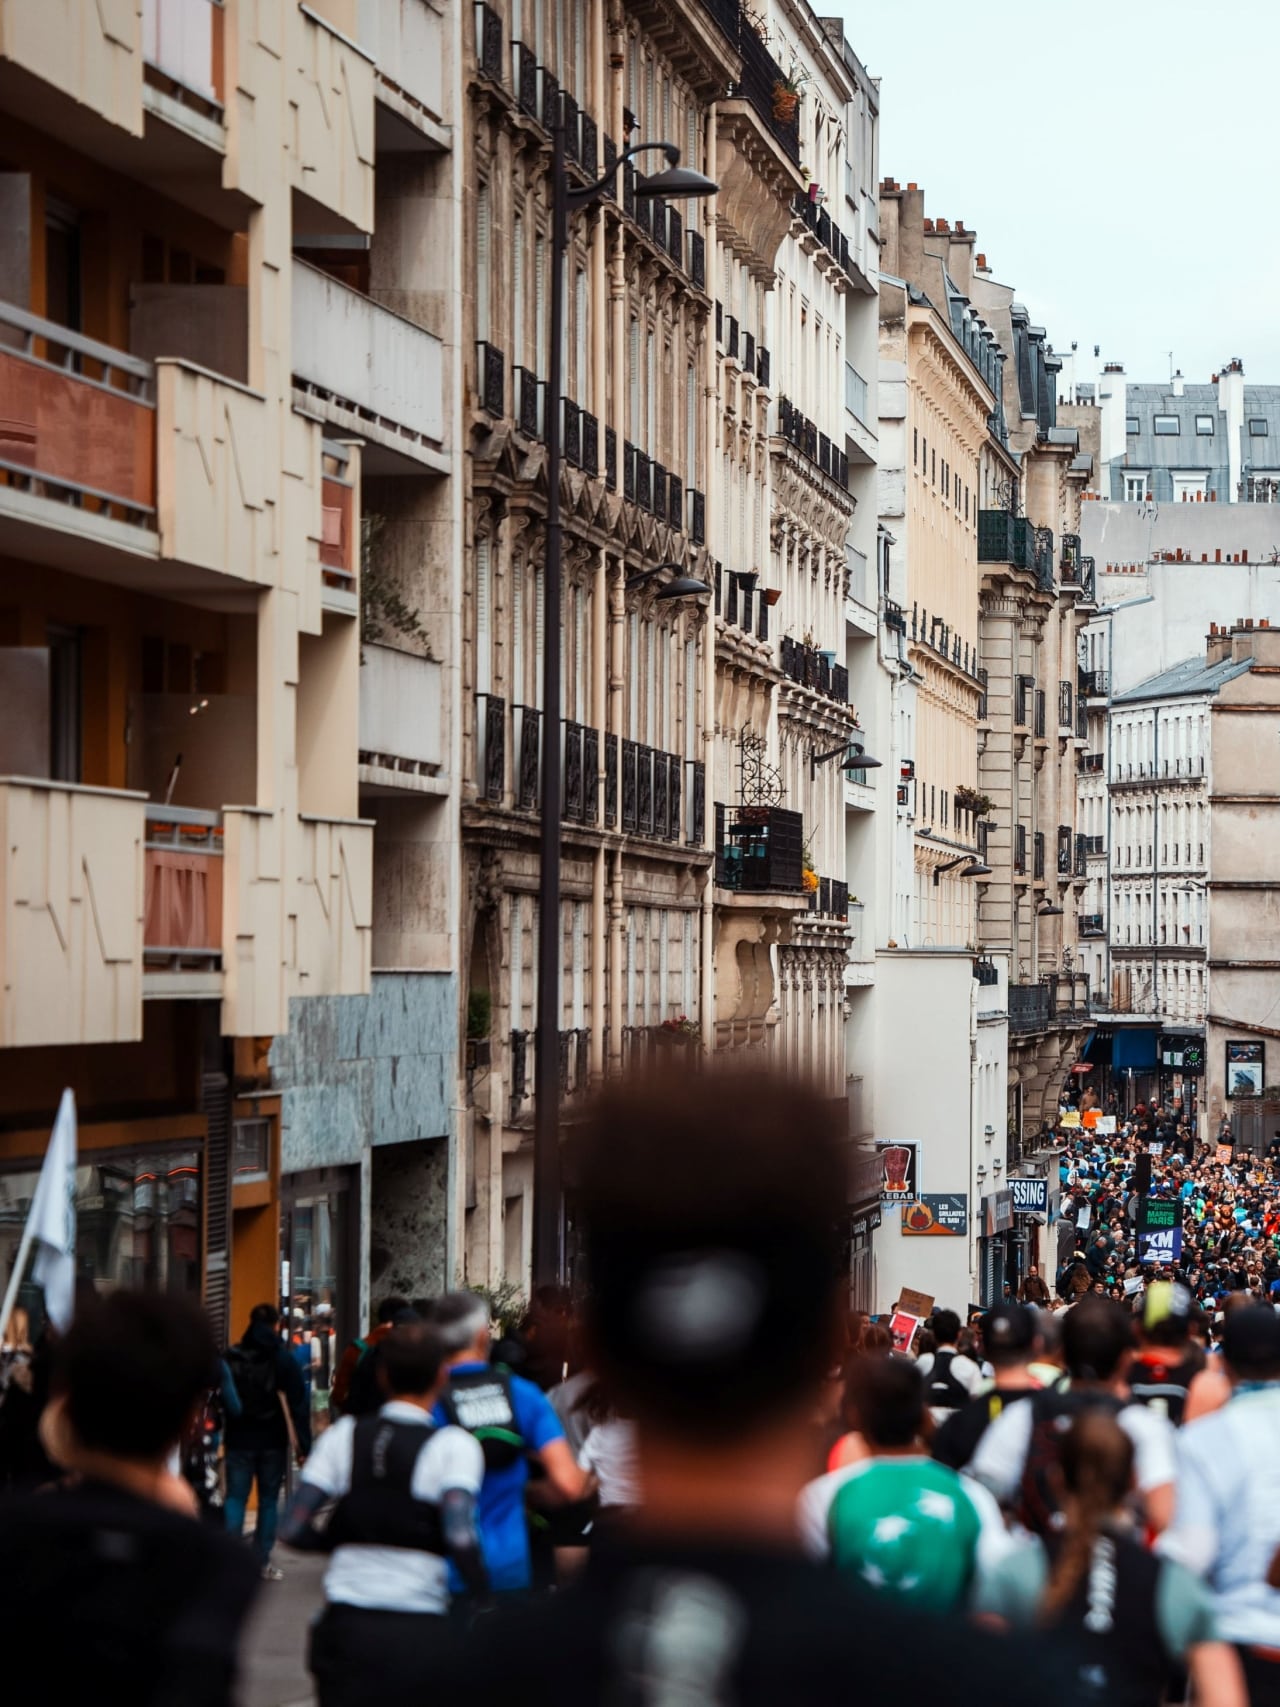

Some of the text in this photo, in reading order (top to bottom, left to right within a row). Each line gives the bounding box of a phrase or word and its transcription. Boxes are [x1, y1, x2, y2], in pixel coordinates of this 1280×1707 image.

[880, 1192, 914, 1200] KEBAB
[1146, 1231, 1174, 1248] KM
[1143, 1249, 1173, 1261] 22
